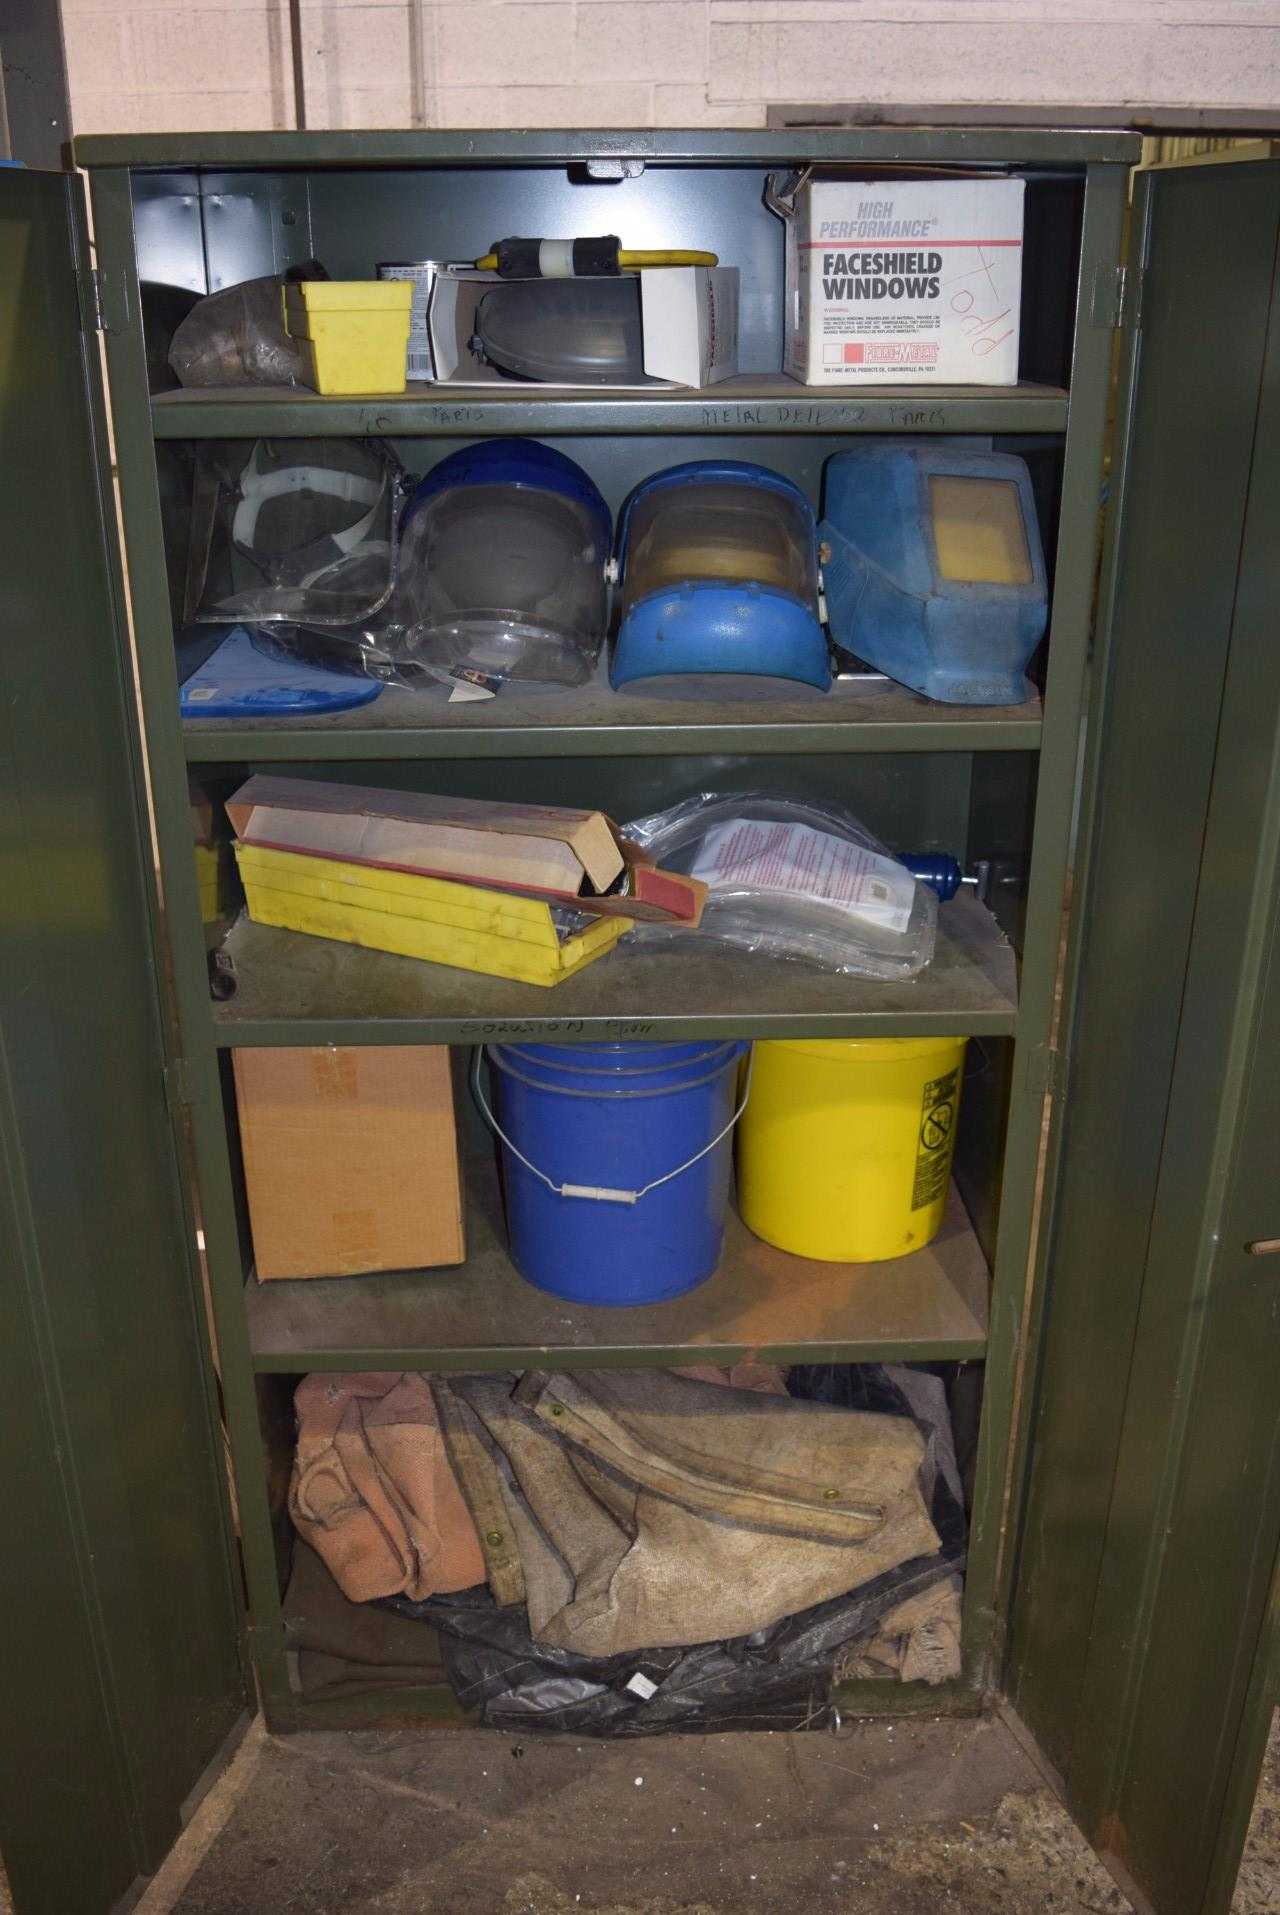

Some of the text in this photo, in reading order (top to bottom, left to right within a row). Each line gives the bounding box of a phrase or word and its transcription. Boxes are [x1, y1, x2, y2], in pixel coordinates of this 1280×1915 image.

[857, 201, 894, 219] HIGH
[823, 252, 943, 275] FACESHIELD
[822, 277, 940, 300] WINDOWS
[702, 407, 764, 425] METAL
